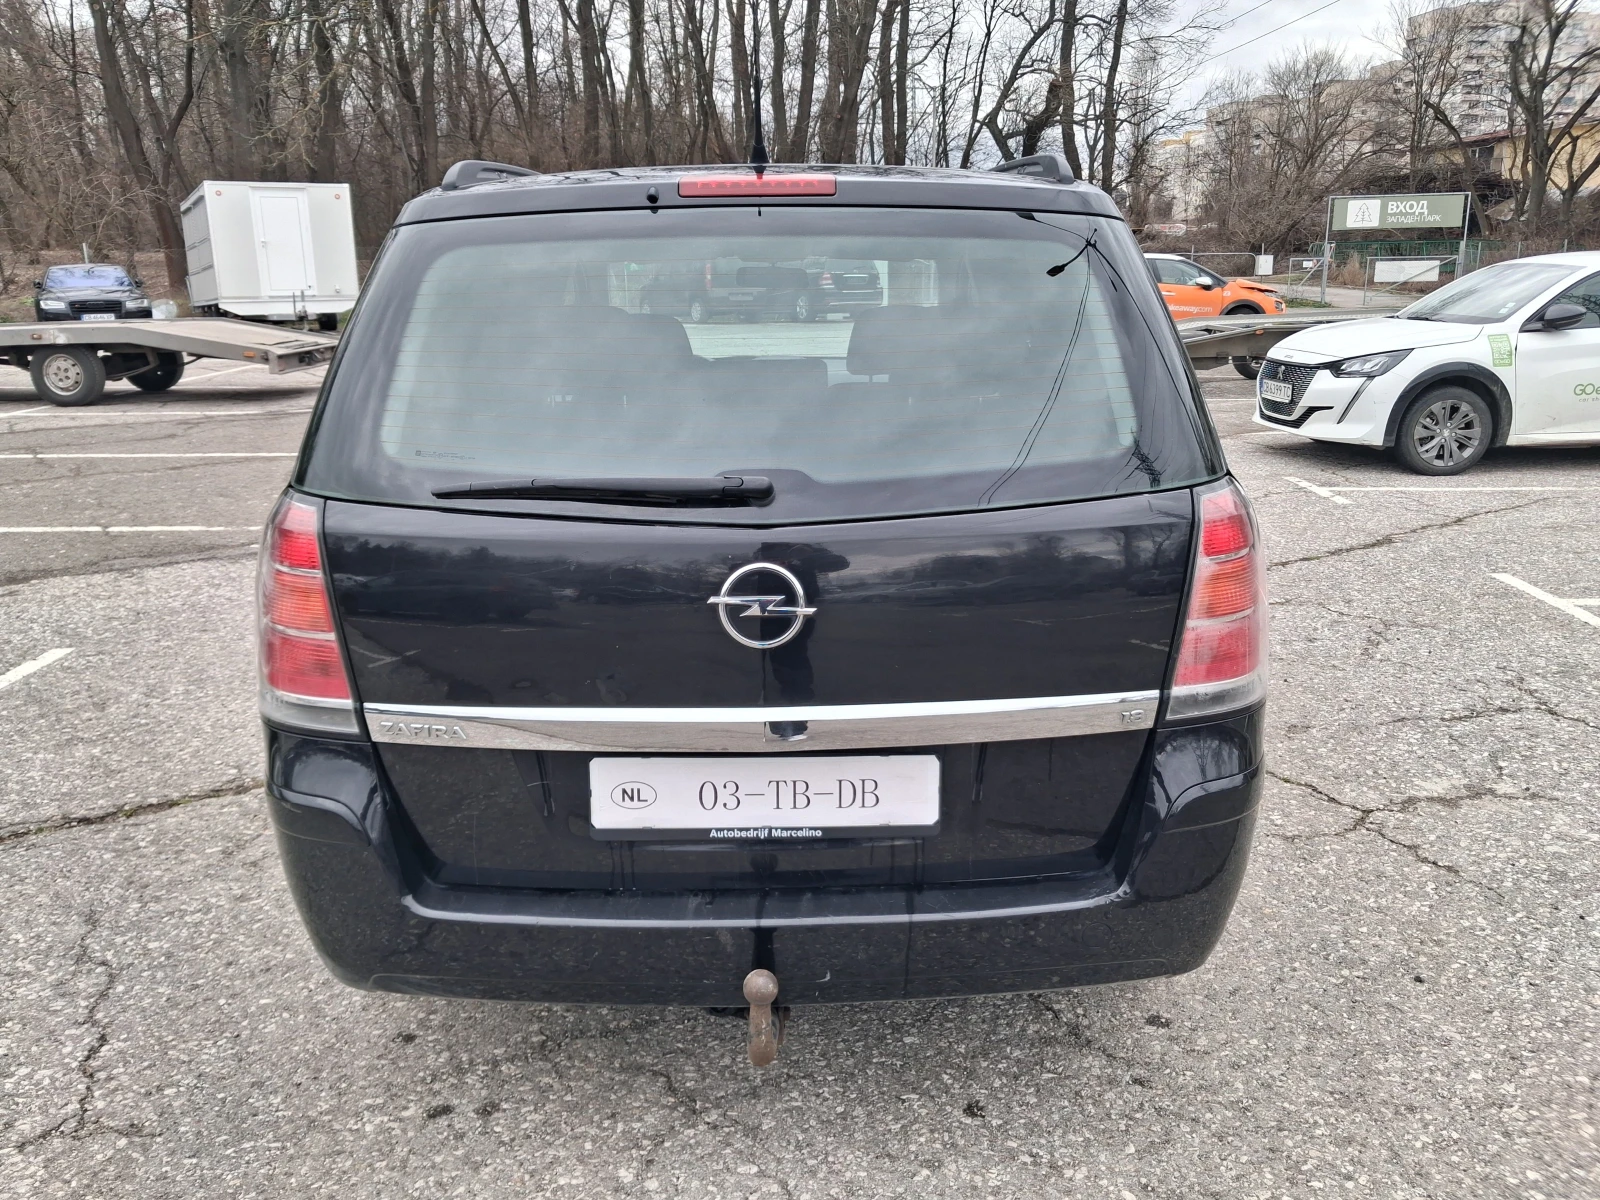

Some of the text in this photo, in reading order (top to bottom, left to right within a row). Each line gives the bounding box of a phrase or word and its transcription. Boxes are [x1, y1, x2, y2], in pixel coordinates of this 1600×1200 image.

[1387, 200, 1428, 215] ВХОД
[1385, 214, 1442, 223] ЗАПАДЕН ПАРК
[1167, 304, 1213, 313] akeaway.com
[379, 721, 467, 739] ZAFIRA
[620, 787, 649, 803] NL
[698, 778, 881, 811] 03-TB-DB
[709, 827, 822, 839] Autobedrijf Marcelino
